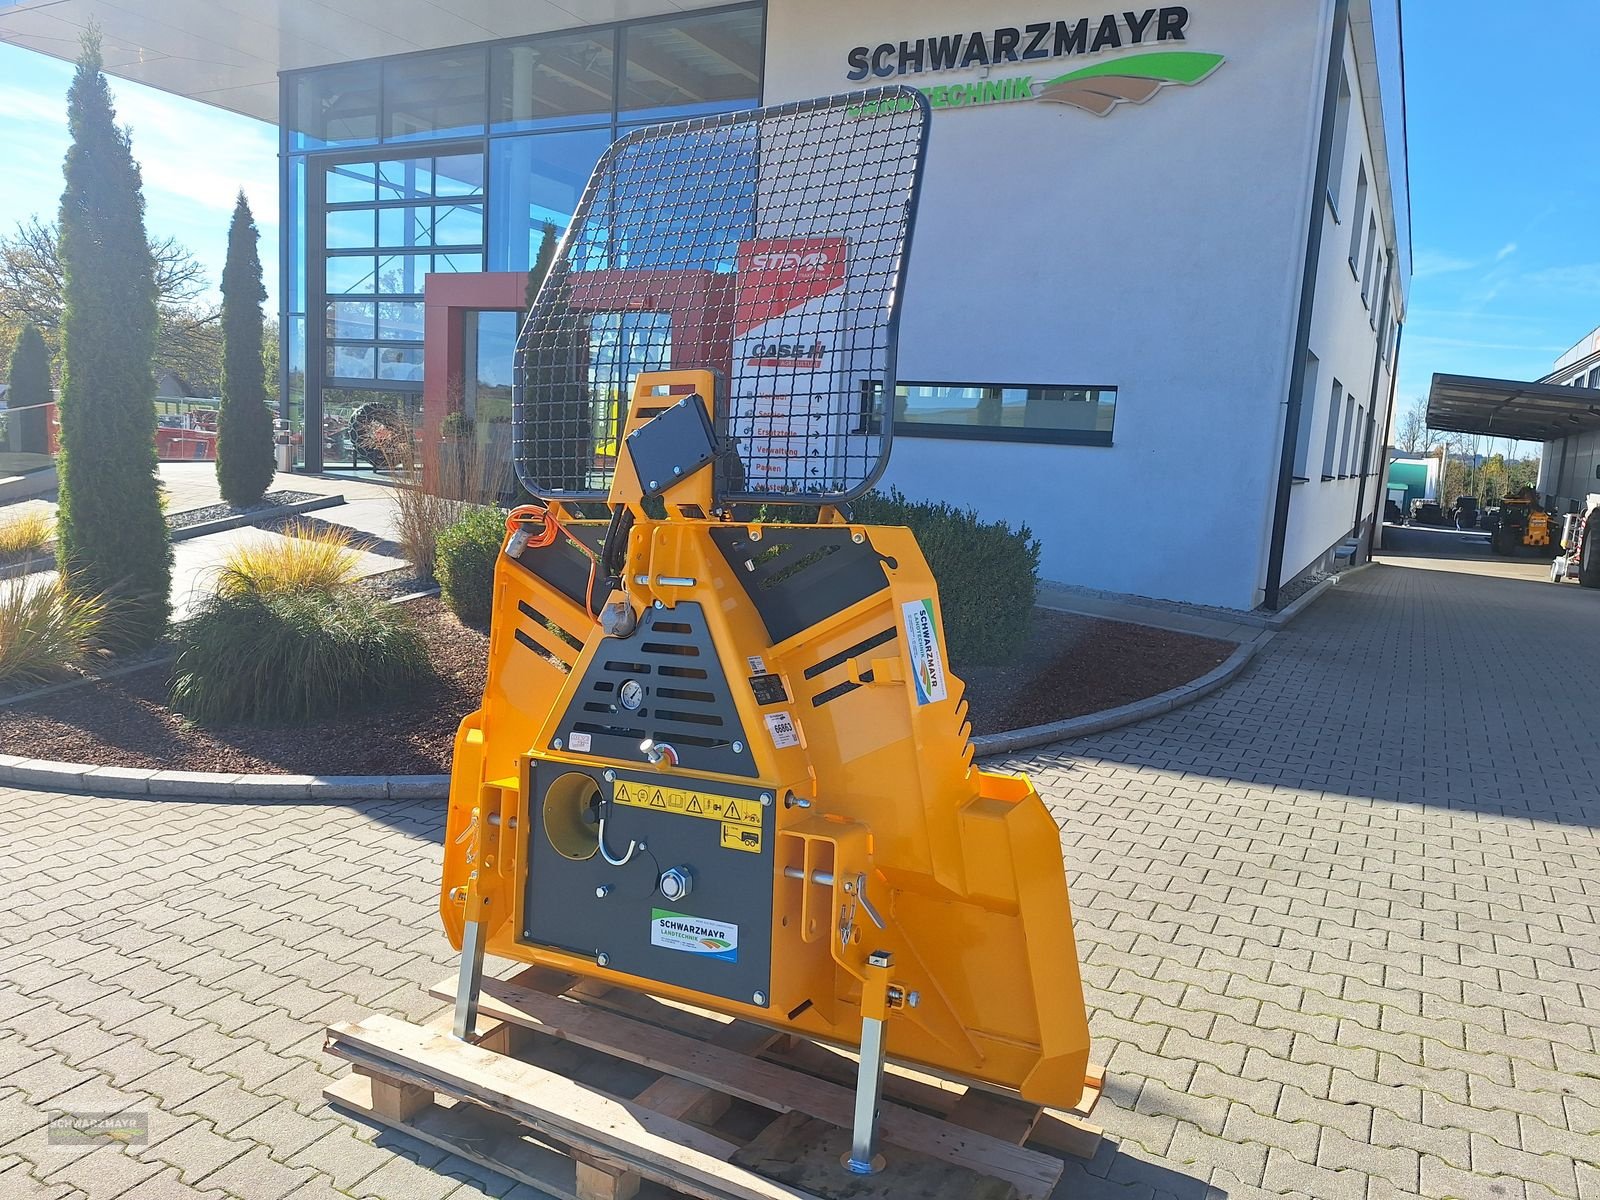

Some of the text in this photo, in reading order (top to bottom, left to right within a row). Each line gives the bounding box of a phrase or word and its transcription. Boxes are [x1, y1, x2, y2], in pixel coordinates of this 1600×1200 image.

[847, 6, 1190, 81] SCHWARZMAYR
[752, 344, 805, 359] CASE
[758, 410, 785, 419] Serice
[756, 463, 782, 472] Paken
[913, 612, 926, 659] LANDTECHNIK
[919, 609, 938, 688] SCHWARZMAYR
[774, 722, 793, 734] 66863
[660, 919, 726, 940] SCHWARZMAYR
[660, 929, 699, 942] LANDTECHNIK
